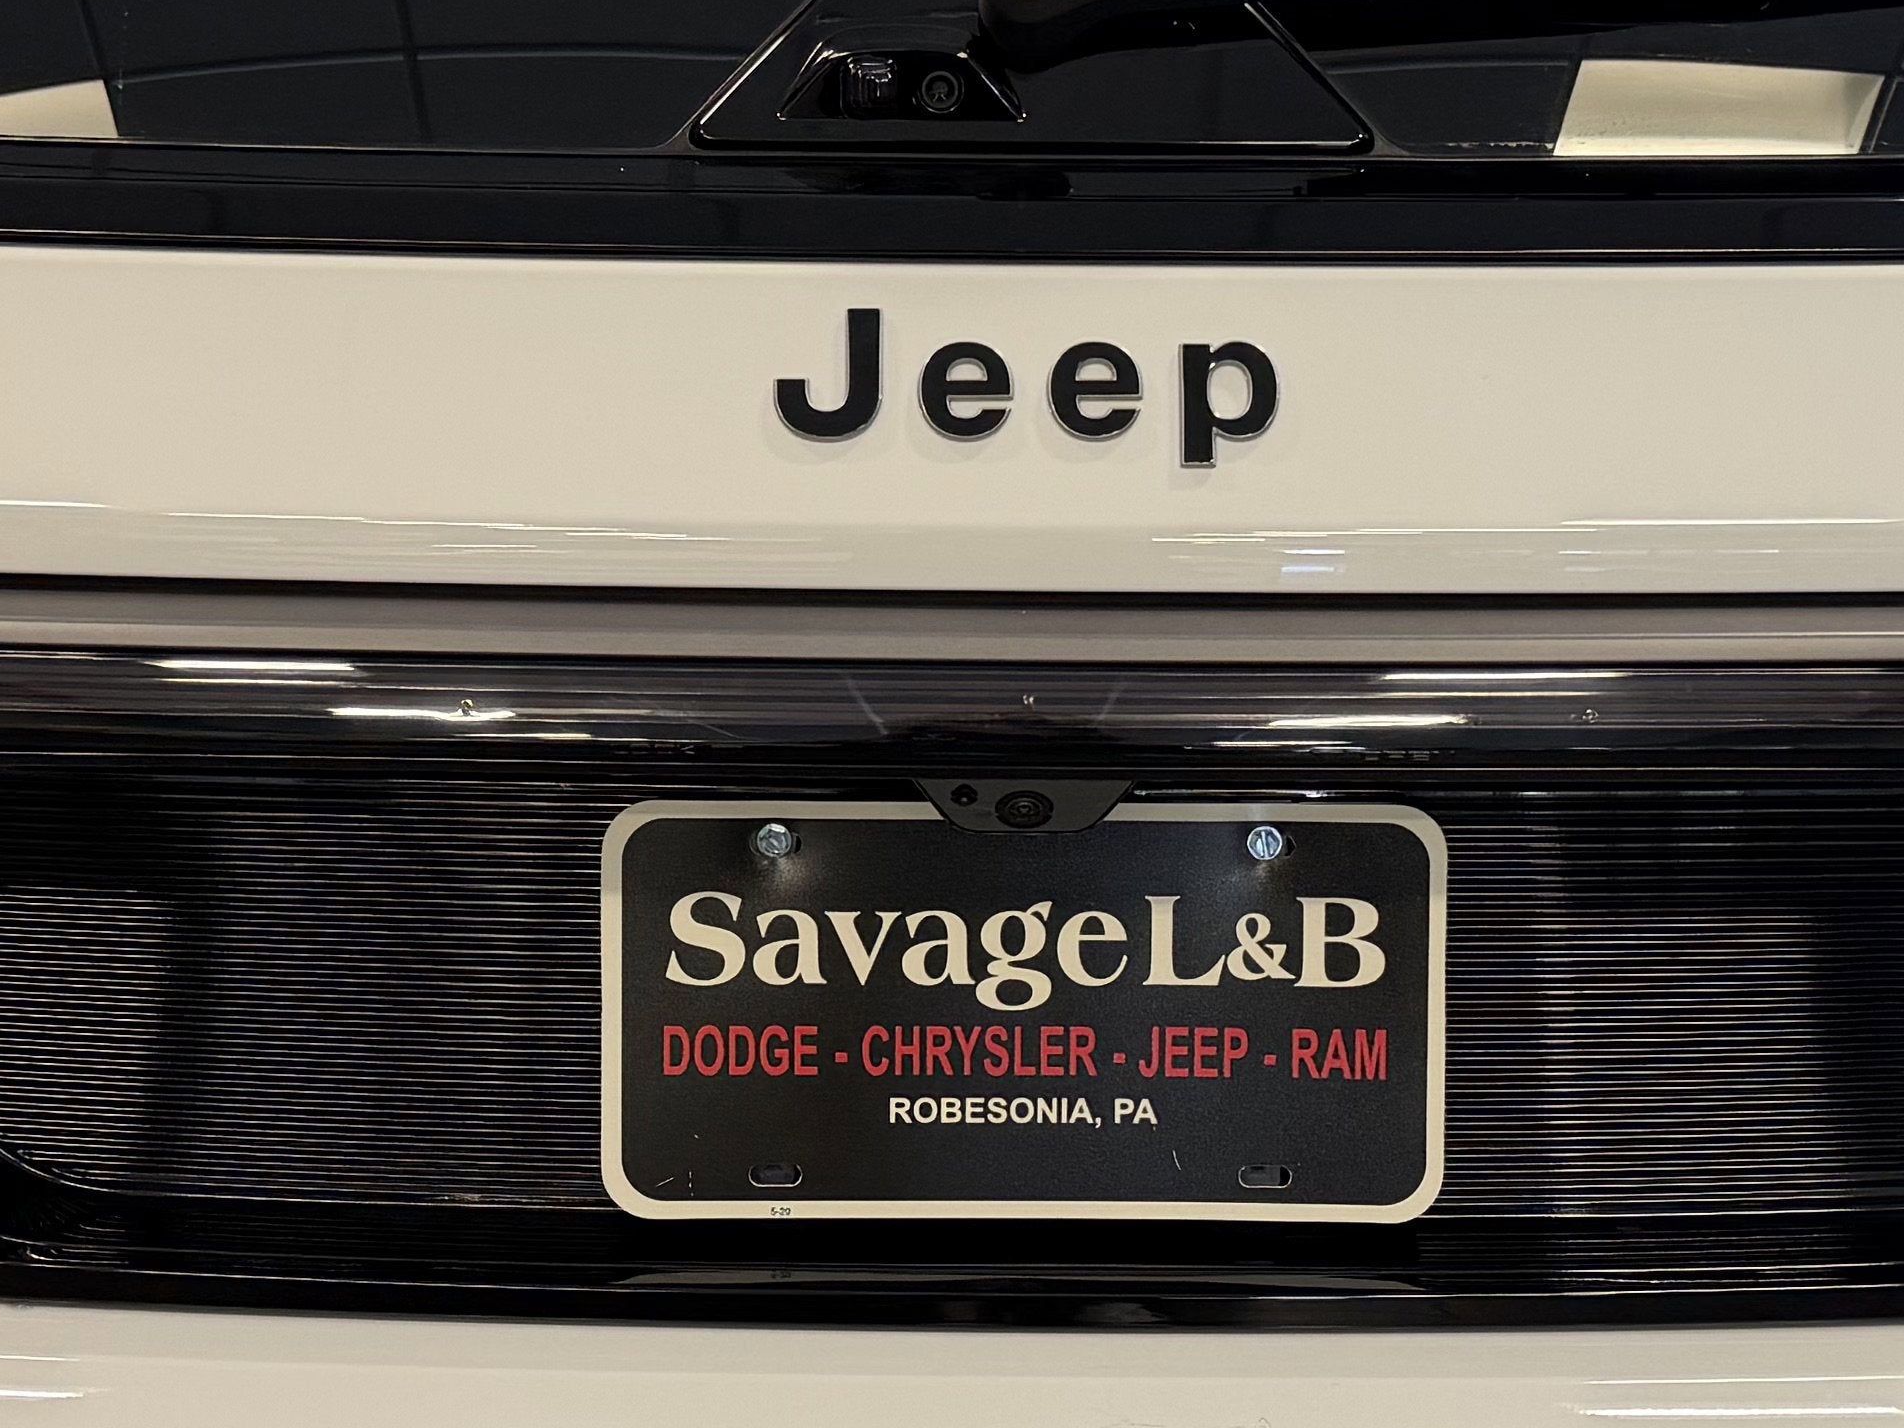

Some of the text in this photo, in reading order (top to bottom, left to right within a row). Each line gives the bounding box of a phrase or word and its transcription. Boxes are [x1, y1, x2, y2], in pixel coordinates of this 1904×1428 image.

[773, 307, 1280, 468] Jeep
[665, 891, 1387, 1011] Savage L&B
[663, 1025, 819, 1077] DODGE
[862, 1026, 1098, 1077] CHRYSLER
[1138, 1026, 1249, 1078] JEEP
[1291, 1029, 1389, 1080] RAM
[888, 1096, 1159, 1130] ROBESONIA, PA
